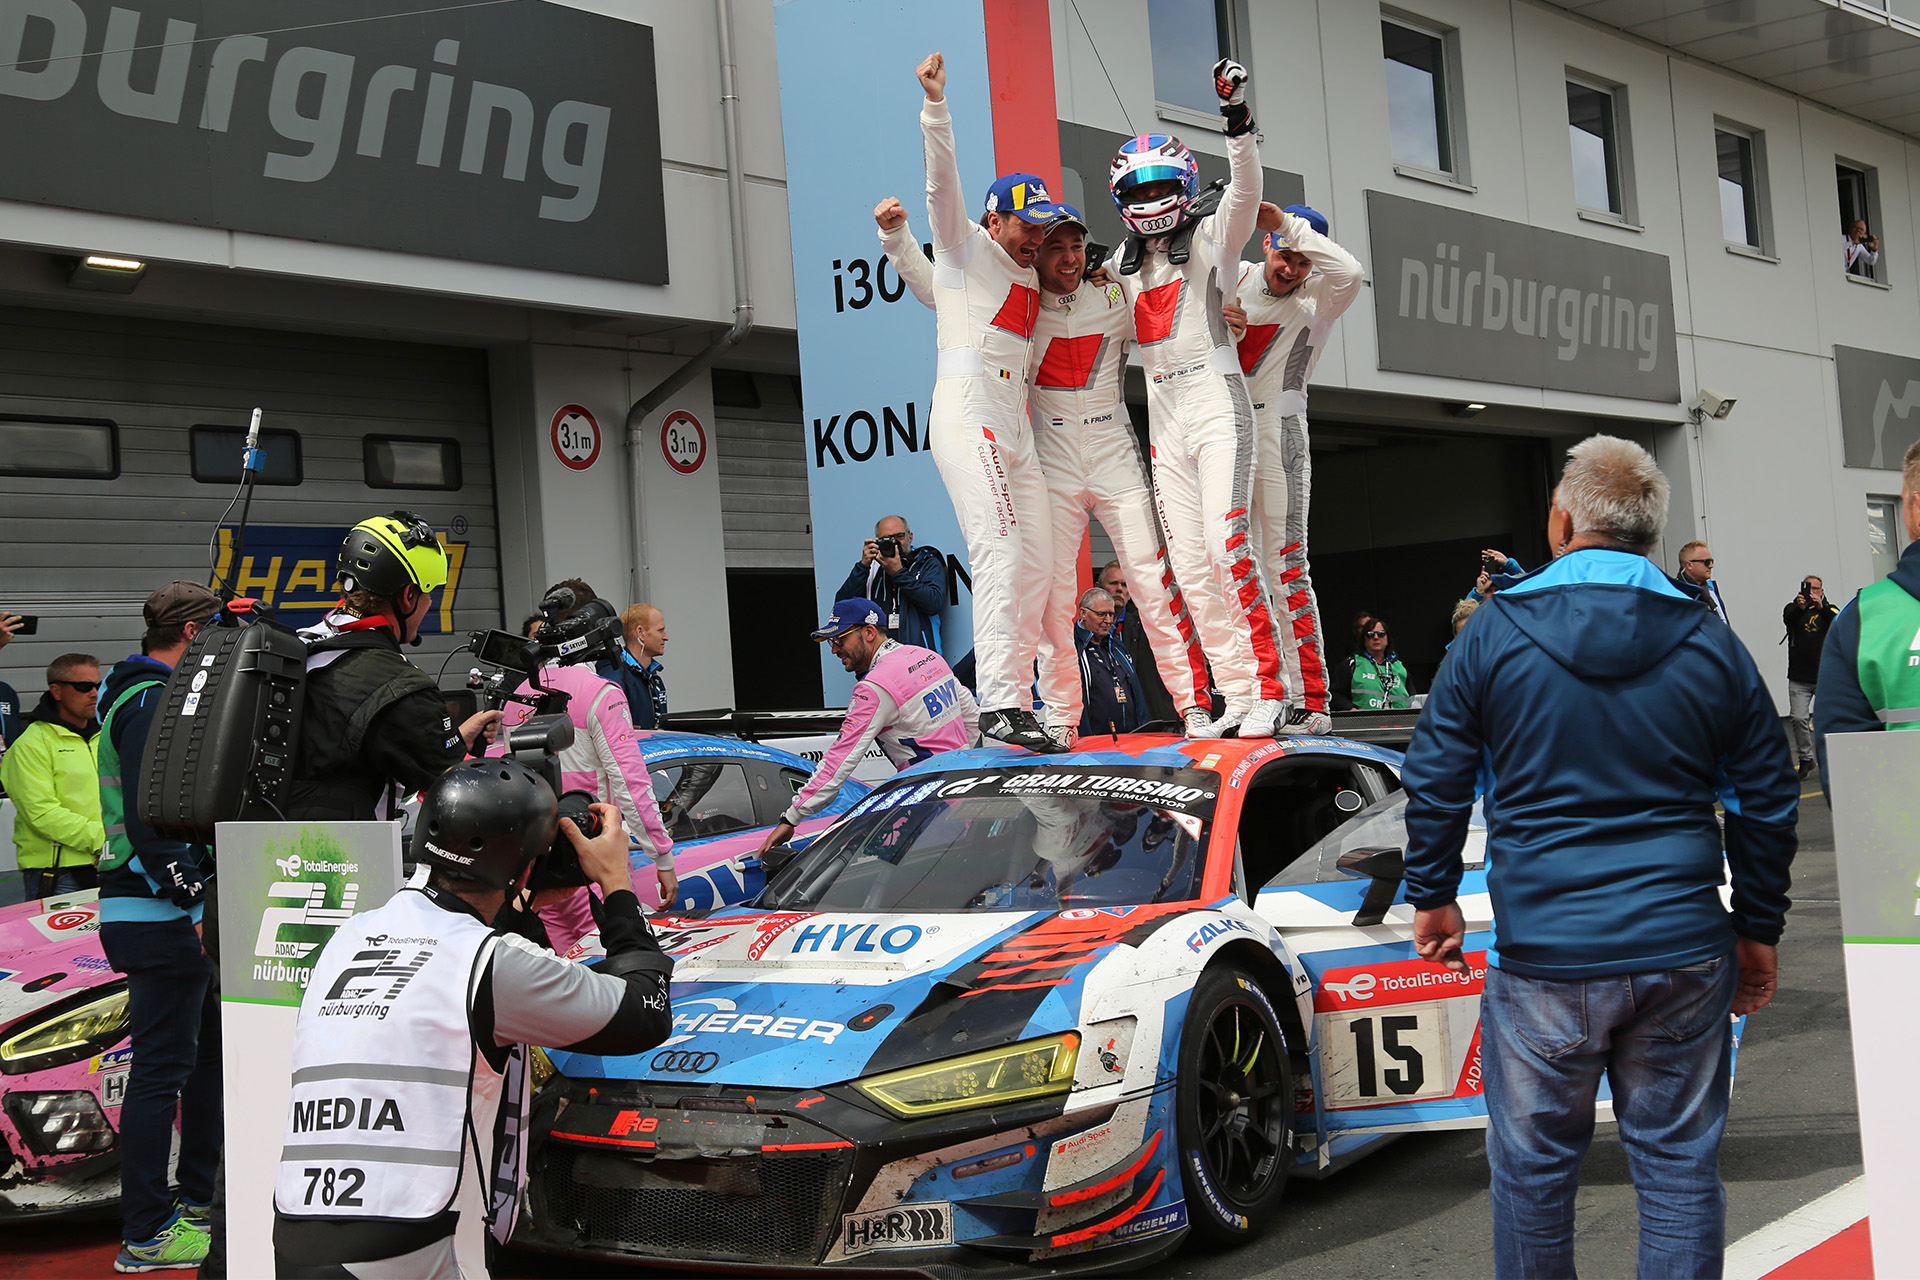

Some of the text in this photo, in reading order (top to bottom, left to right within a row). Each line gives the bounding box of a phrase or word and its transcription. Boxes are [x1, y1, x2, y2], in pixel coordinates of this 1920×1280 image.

[832, 258, 906, 314] i30
[1399, 242, 1659, 372] nürburgring
[977, 445, 1009, 537] customer racing
[989, 443, 1017, 527] Audi Sport
[922, 678, 958, 719] BWT
[1231, 759, 1252, 781] FRIJNS
[1252, 747, 1268, 760] VAN
[1266, 743, 1280, 756] DER
[998, 787, 1022, 795] THE
[1056, 788, 1108, 798] DRIVING
[1109, 791, 1187, 810] SIMULATOR
[1001, 773, 1204, 803] GRAN TURISMO
[302, 859, 360, 877] TotalEnergies
[424, 841, 476, 866] POWERSLIDE
[166, 861, 203, 897] TEM
[274, 943, 297, 957] ADAC
[387, 936, 440, 947] TotalEnergies
[791, 924, 922, 955] HYLO
[253, 959, 314, 990] nürburg
[317, 1000, 391, 1021] nürburgring
[665, 1002, 846, 1046] HERER
[1350, 1015, 1425, 1097] 15
[292, 1097, 406, 1134] MEDIA
[1067, 1127, 1112, 1149] Audi Sport
[303, 1166, 367, 1208] 782
[848, 1212, 907, 1248] H&R
[1114, 1211, 1179, 1237] MICHELIN
